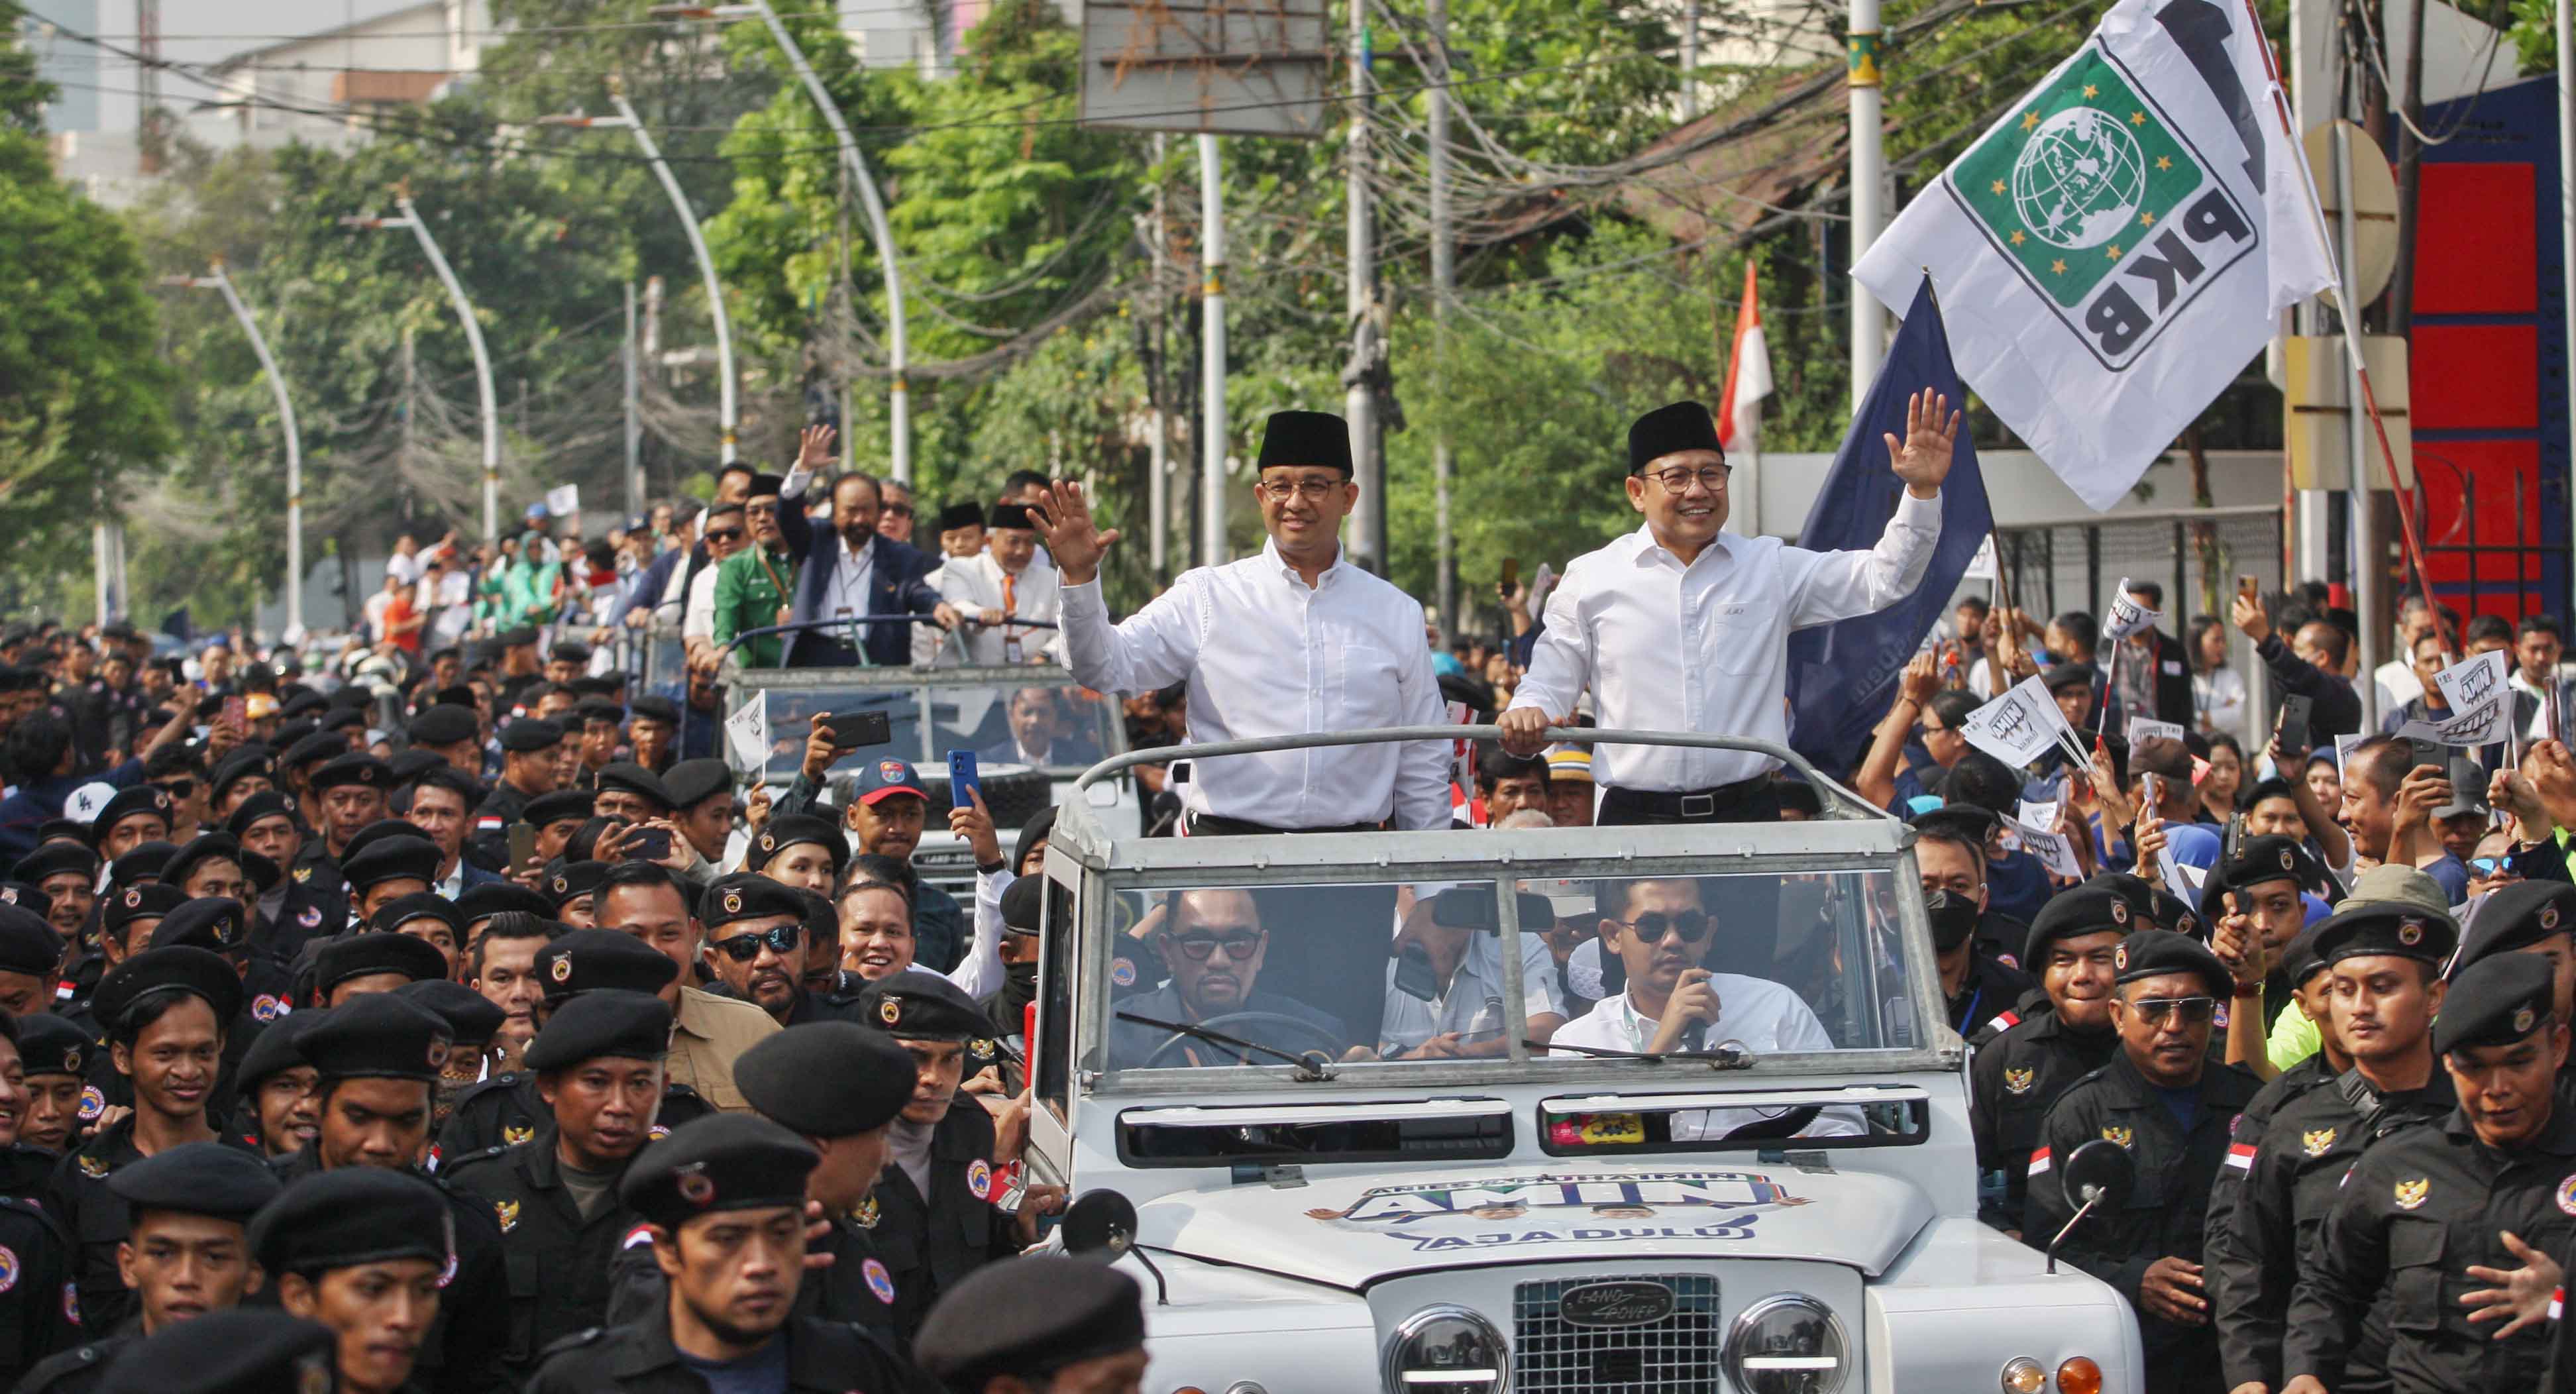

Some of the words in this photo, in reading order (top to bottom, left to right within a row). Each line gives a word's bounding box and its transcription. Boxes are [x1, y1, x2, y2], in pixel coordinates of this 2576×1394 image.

[2462, 665, 2492, 704] AMIN
[1991, 701, 2025, 739] AMIN
[1348, 1182, 1756, 1218] AMIN
[1427, 1230, 1562, 1249] AJA
[1573, 1228, 1731, 1241] DULU
[1577, 1289, 1623, 1304] LAND
[1603, 1305, 1658, 1319] ROVER
